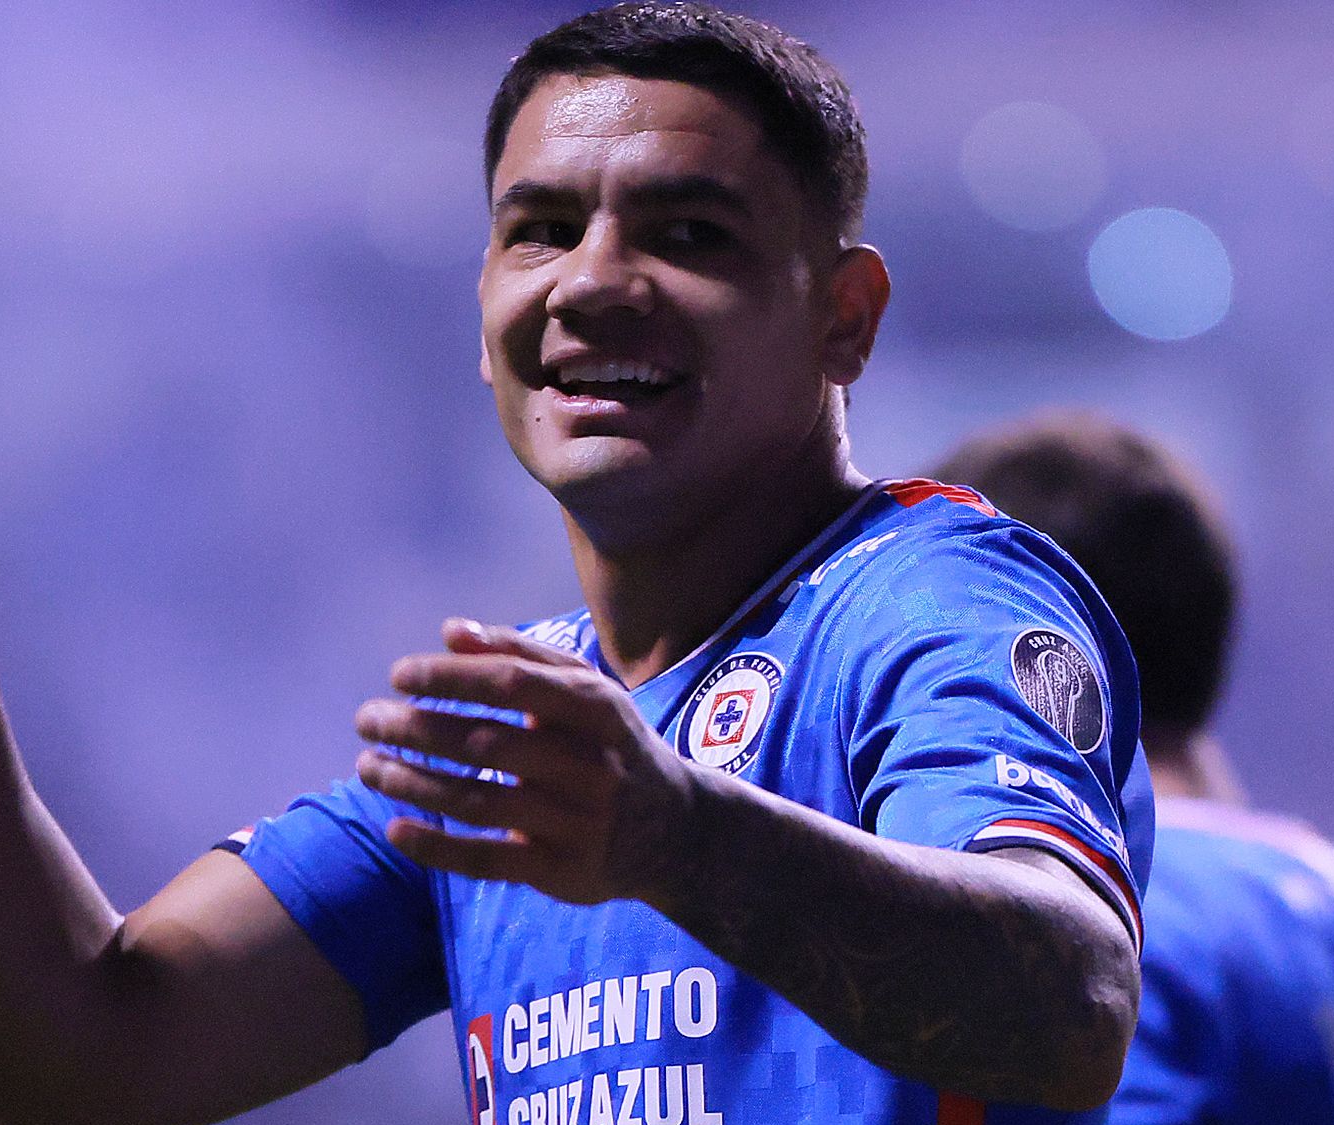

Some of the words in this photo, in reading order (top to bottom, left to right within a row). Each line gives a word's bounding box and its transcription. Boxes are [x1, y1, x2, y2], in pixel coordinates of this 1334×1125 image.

[1028, 635, 1057, 649] CRUZ
[695, 669, 723, 702] CLUB
[729, 658, 746, 670] DE
[725, 752, 751, 775] ZUL
[502, 966, 718, 1074] CEMENTO
